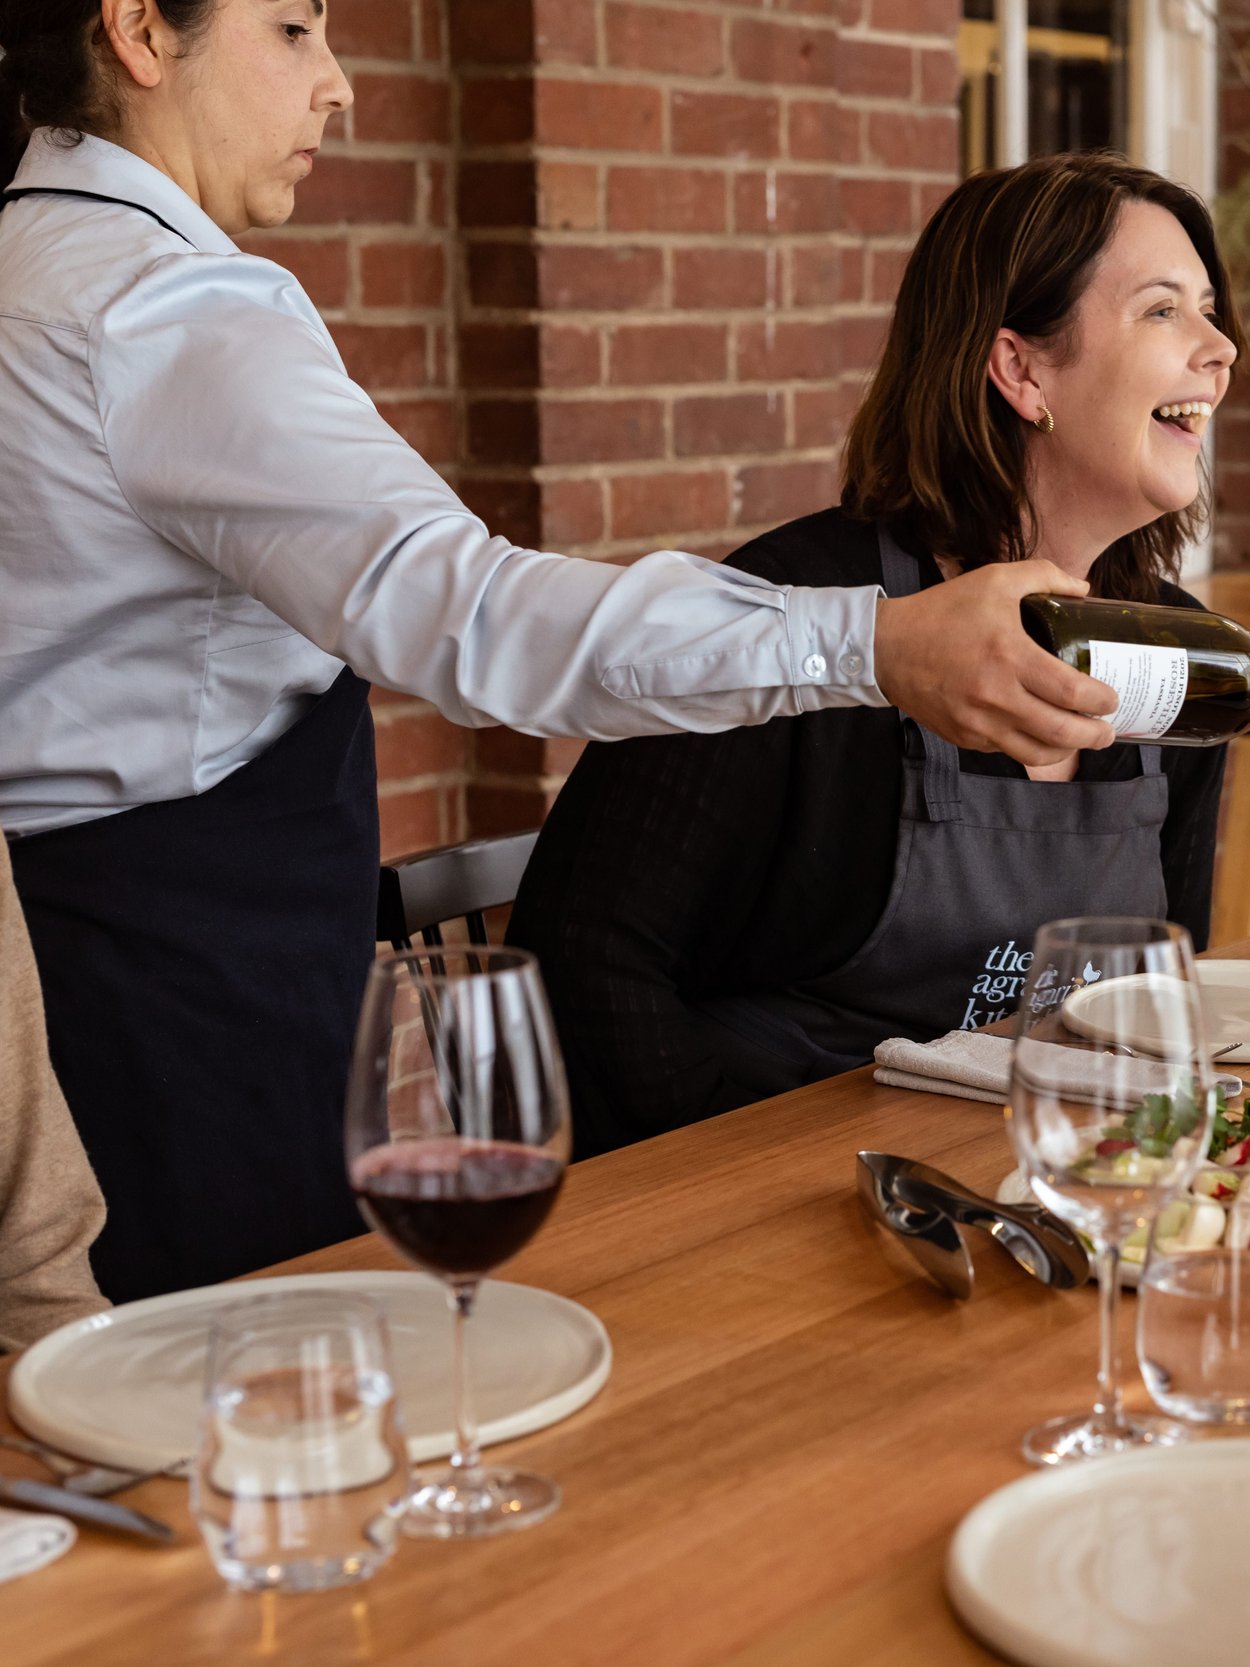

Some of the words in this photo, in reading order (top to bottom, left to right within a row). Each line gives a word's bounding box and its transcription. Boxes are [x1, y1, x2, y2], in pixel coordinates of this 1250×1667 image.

[1149, 678, 1165, 719] TASMANIA
[1171, 683, 1184, 714] PINOT
[984, 940, 1035, 971] the
